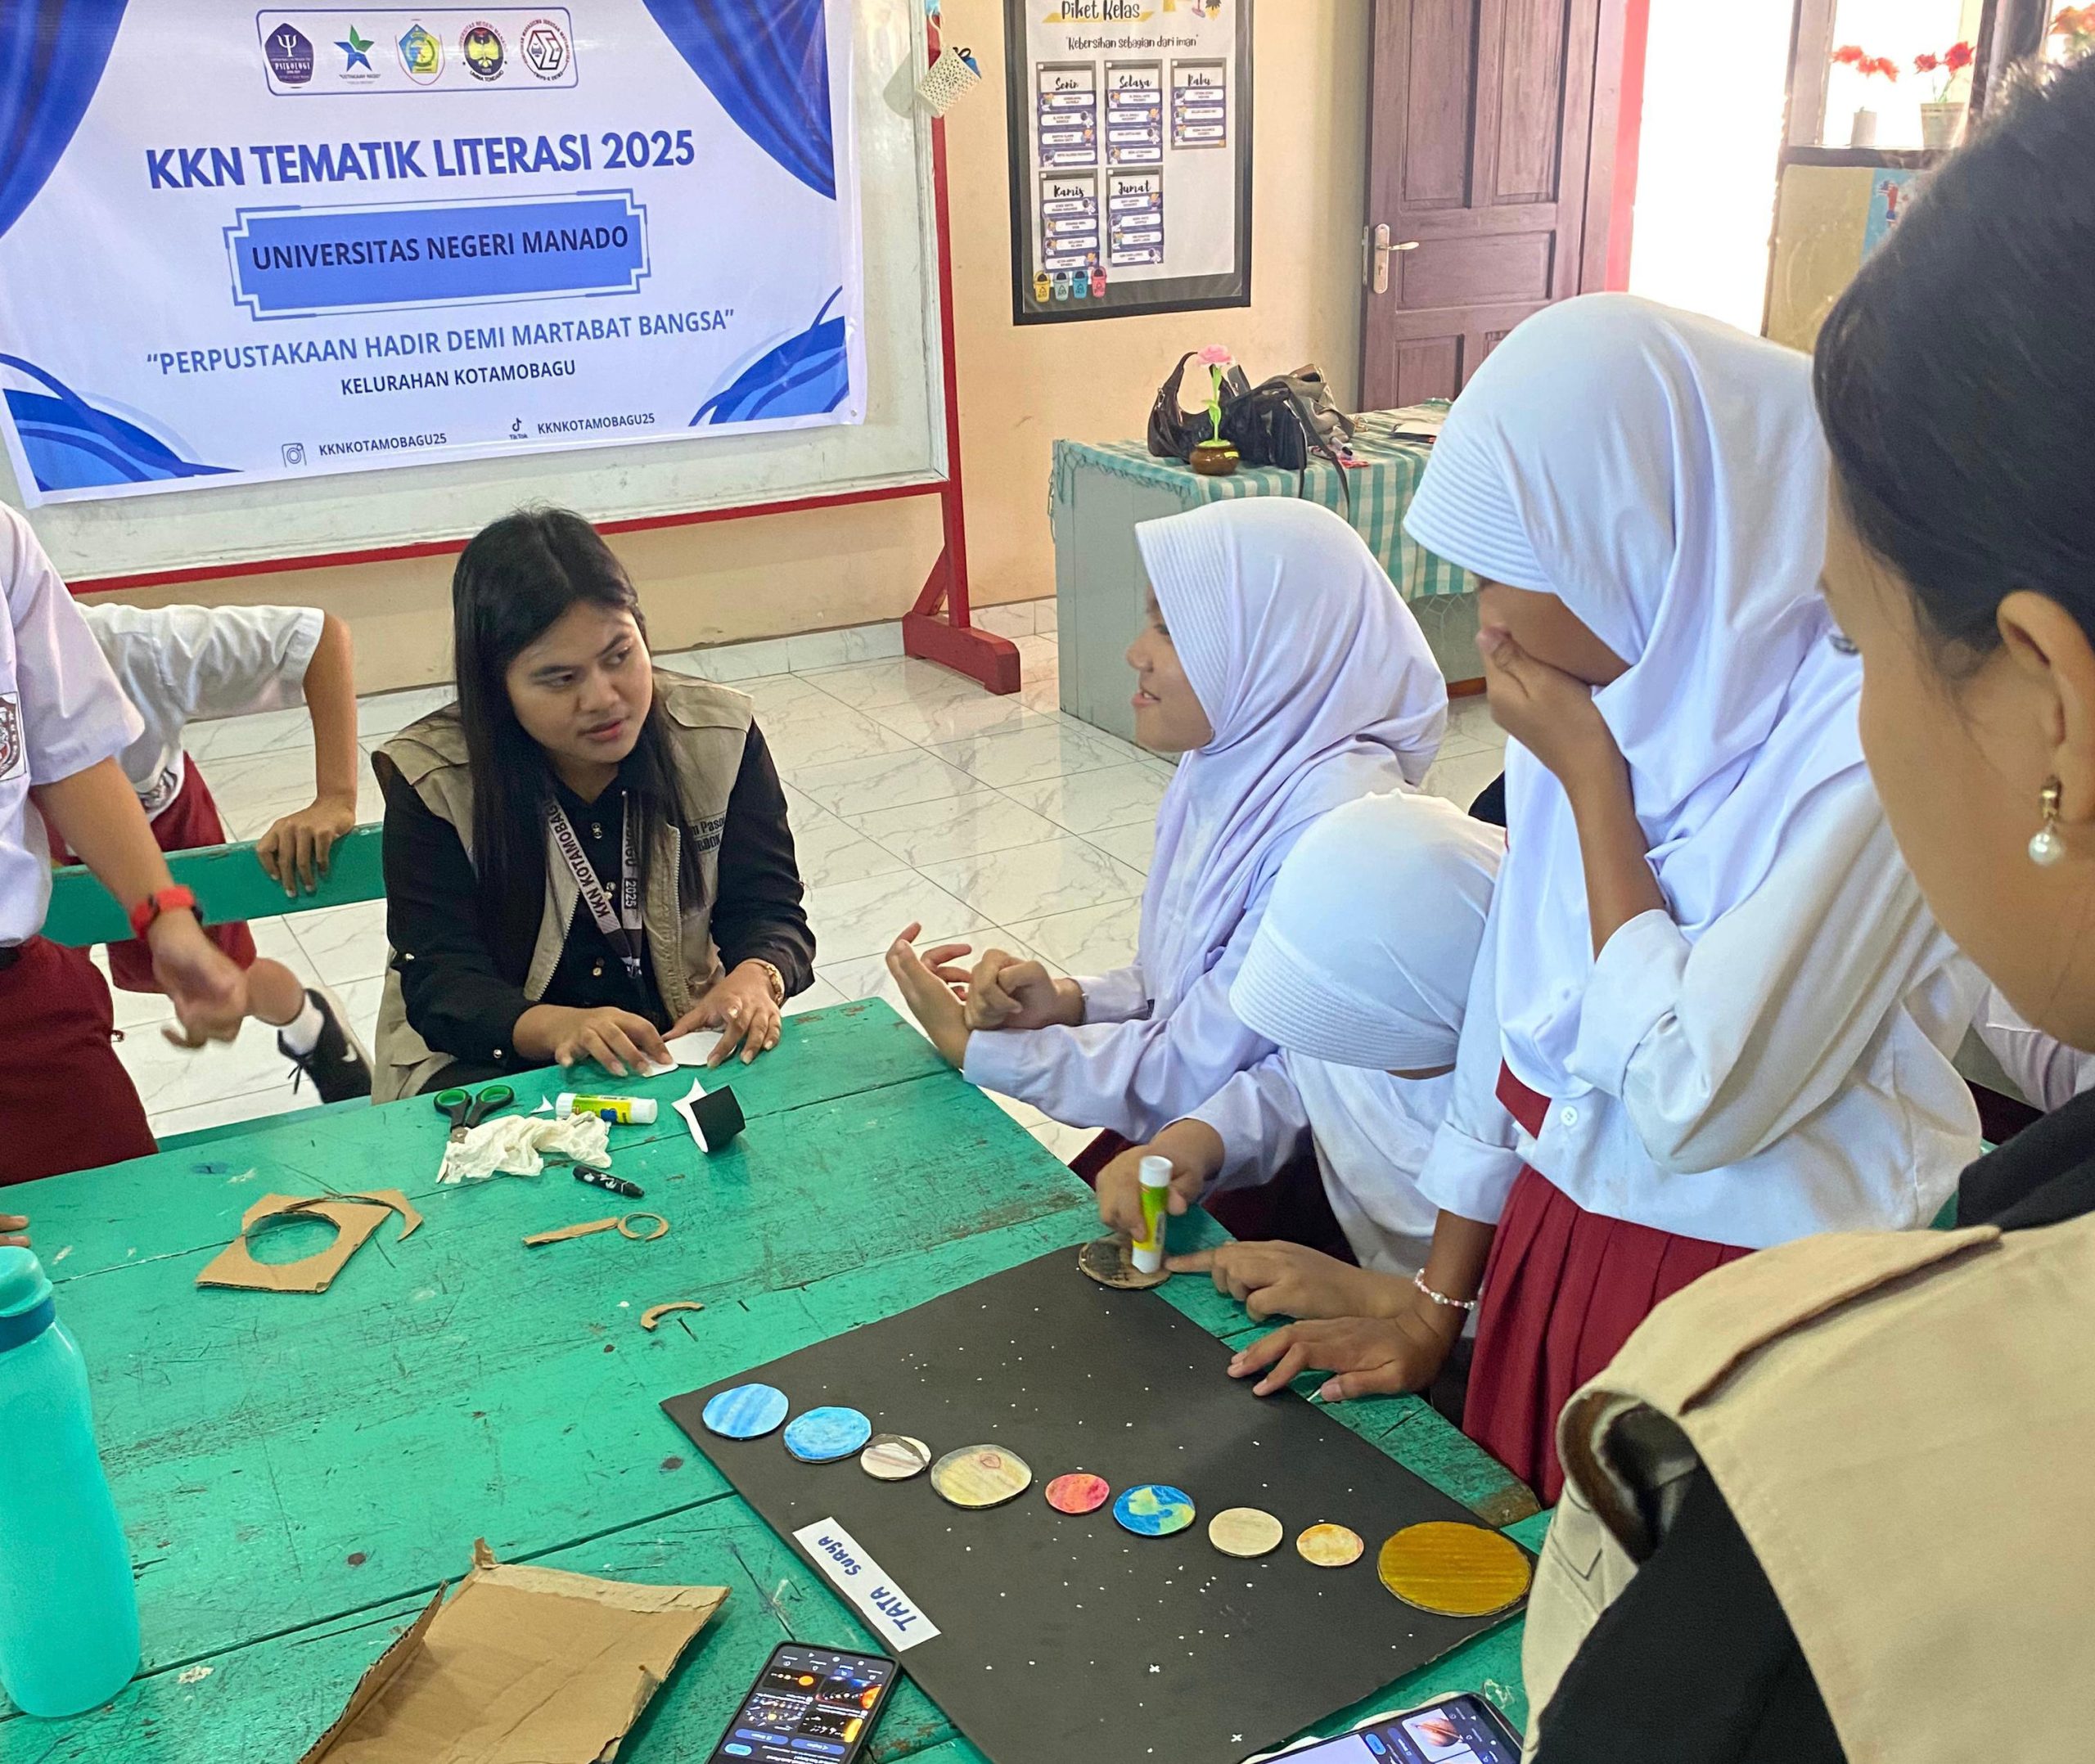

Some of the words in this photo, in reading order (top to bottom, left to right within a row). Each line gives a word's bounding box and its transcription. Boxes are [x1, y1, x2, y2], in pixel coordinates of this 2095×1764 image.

[1061, 0, 1100, 20] Piket
[1103, 0, 1141, 20] Kelas
[1118, 35, 1155, 49] sebagian
[1156, 35, 1174, 47] dari
[1055, 76, 1079, 91] Senin
[1120, 74, 1152, 89] Selasa
[1187, 72, 1212, 87] Rabu
[146, 147, 246, 190] KKN
[250, 141, 429, 185] TEMATIK
[433, 134, 592, 178] LITERASI
[601, 129, 696, 170] 2025
[1053, 184, 1085, 198] Kamis
[1117, 179, 1151, 196] Jumat
[253, 239, 420, 270] UNIVERSITAS
[427, 233, 515, 260] NEGERI
[522, 226, 628, 254] MANADO
[146, 338, 358, 376] “PERPUSTAKAAN
[365, 331, 442, 358] HADIR
[447, 326, 505, 352] DEMI
[512, 317, 633, 347] MARTABAT
[638, 308, 734, 336] BANGSA”
[341, 371, 448, 396] KELURAHAN
[454, 360, 576, 385] KOTAMOBAGU
[537, 413, 656, 434] KKNKOTAMOBAGU25
[318, 433, 448, 457] KKNKOTAMOBAGU25
[586, 888, 610, 917] KKN
[625, 880, 637, 907] 2025
[870, 1586, 917, 1631] TATA
